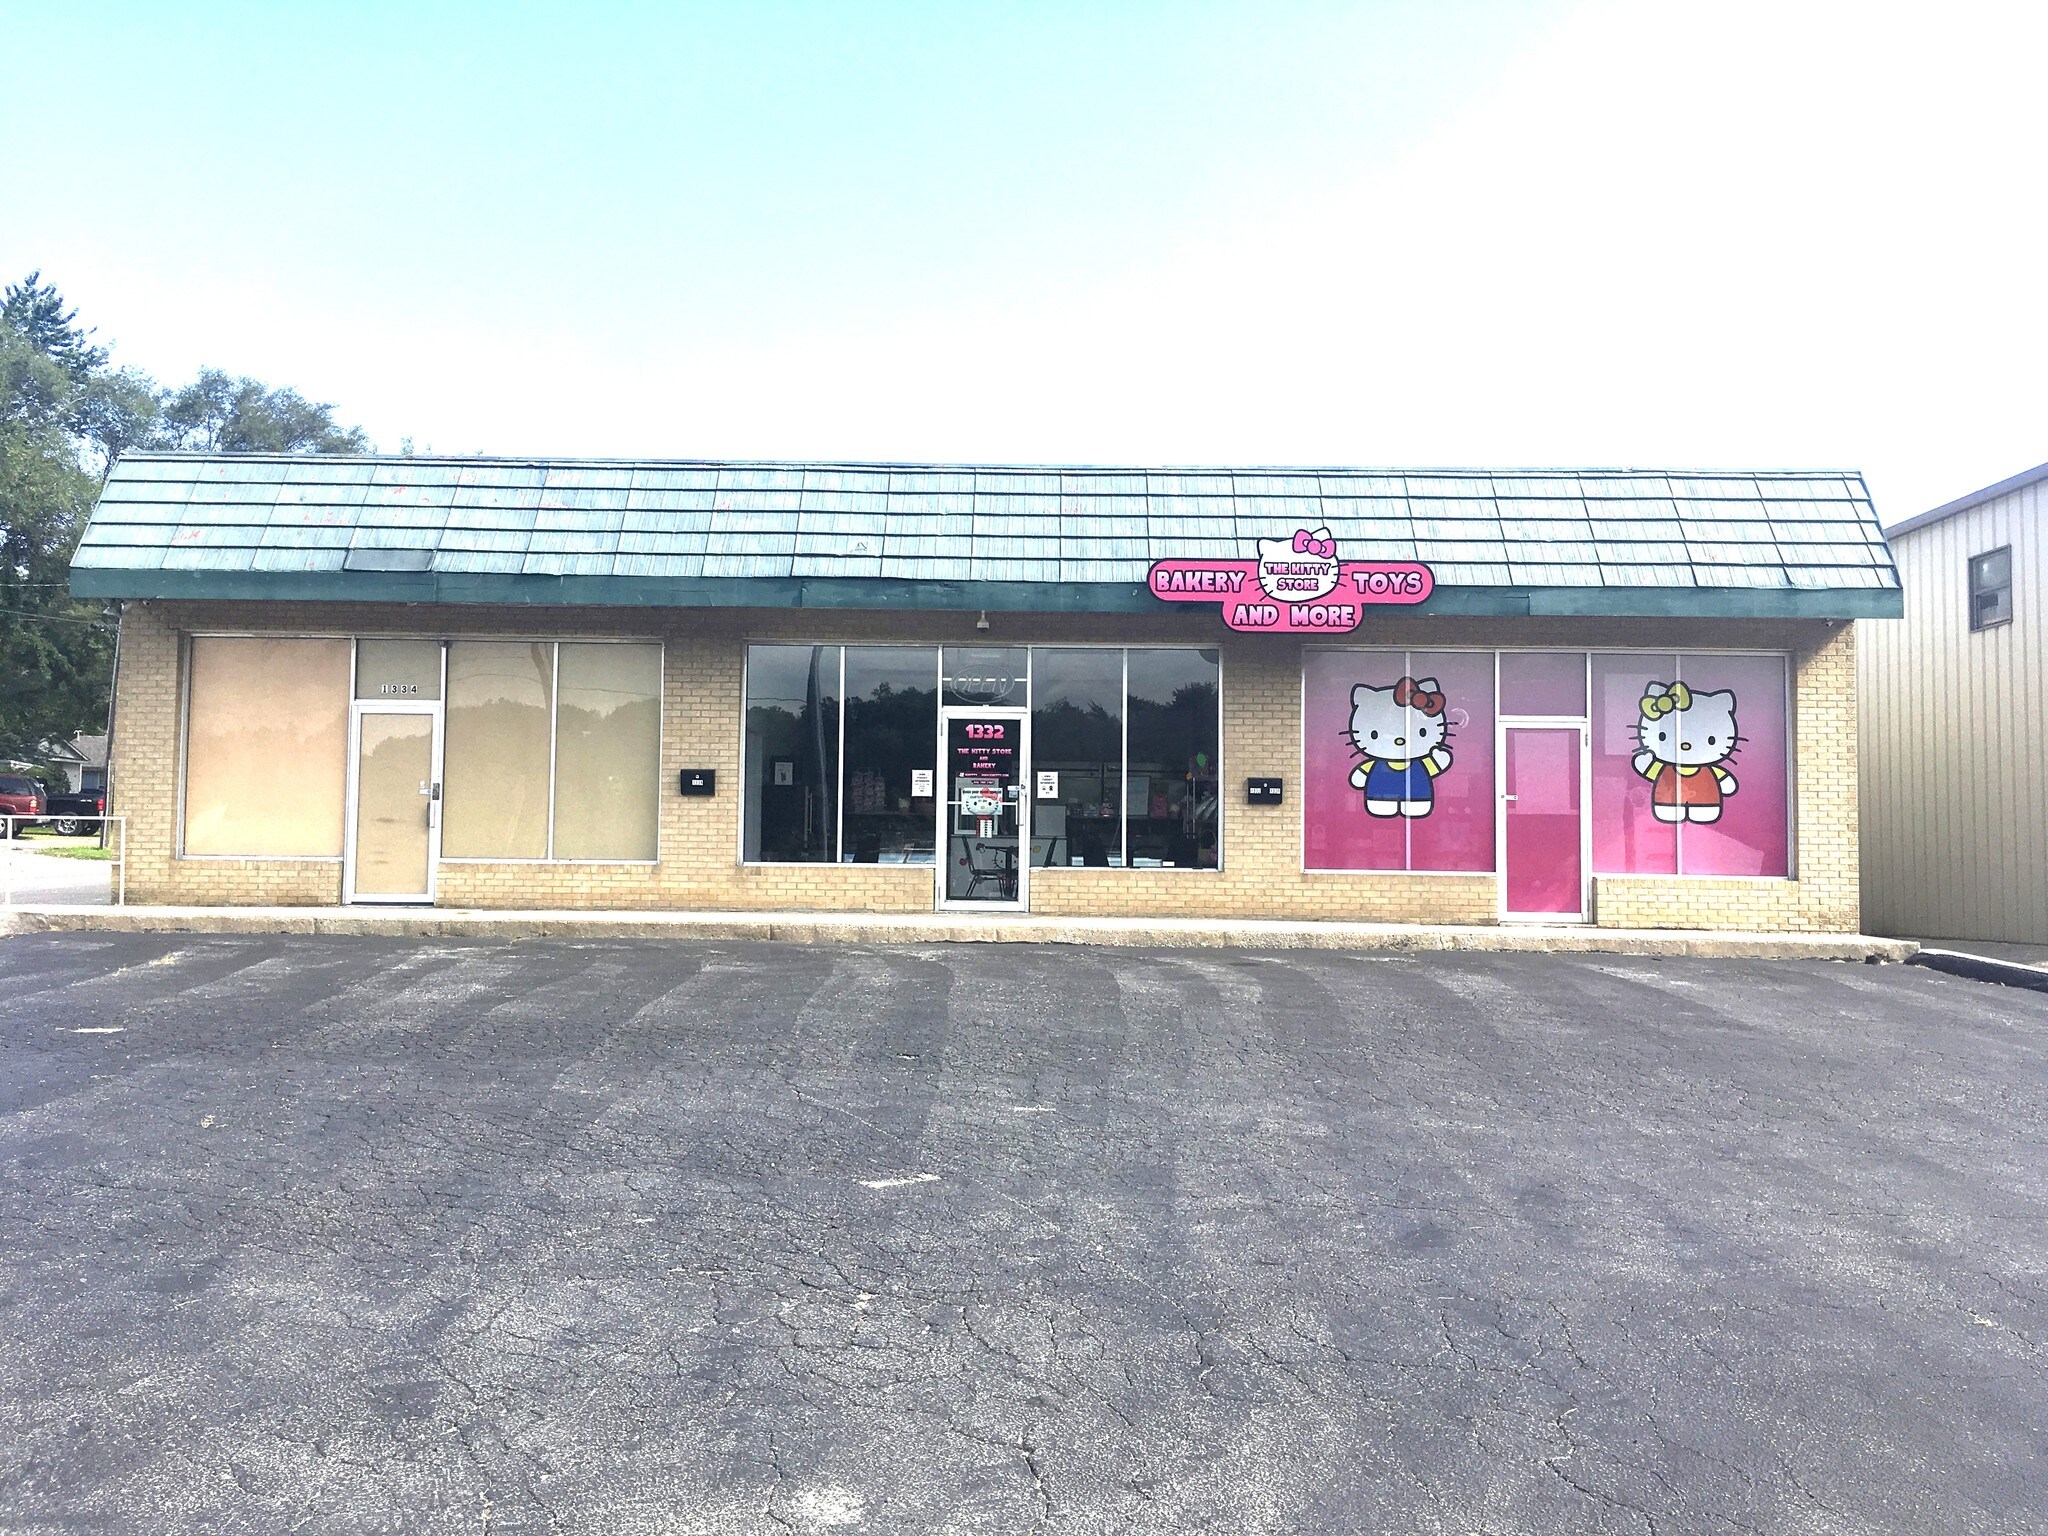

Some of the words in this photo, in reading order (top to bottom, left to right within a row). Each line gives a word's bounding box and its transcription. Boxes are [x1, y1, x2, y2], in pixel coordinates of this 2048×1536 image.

[1264, 562, 1289, 575] THE
[1291, 562, 1331, 575] KITTY
[1156, 570, 1246, 592] BAKERY
[1277, 578, 1318, 591] STORE
[1352, 571, 1423, 594] TOYS
[1232, 604, 1279, 626] AND
[1290, 604, 1355, 627] MORE
[382, 685, 417, 694] 1334
[954, 673, 1009, 693] OPEN
[965, 724, 1005, 739] 1332
